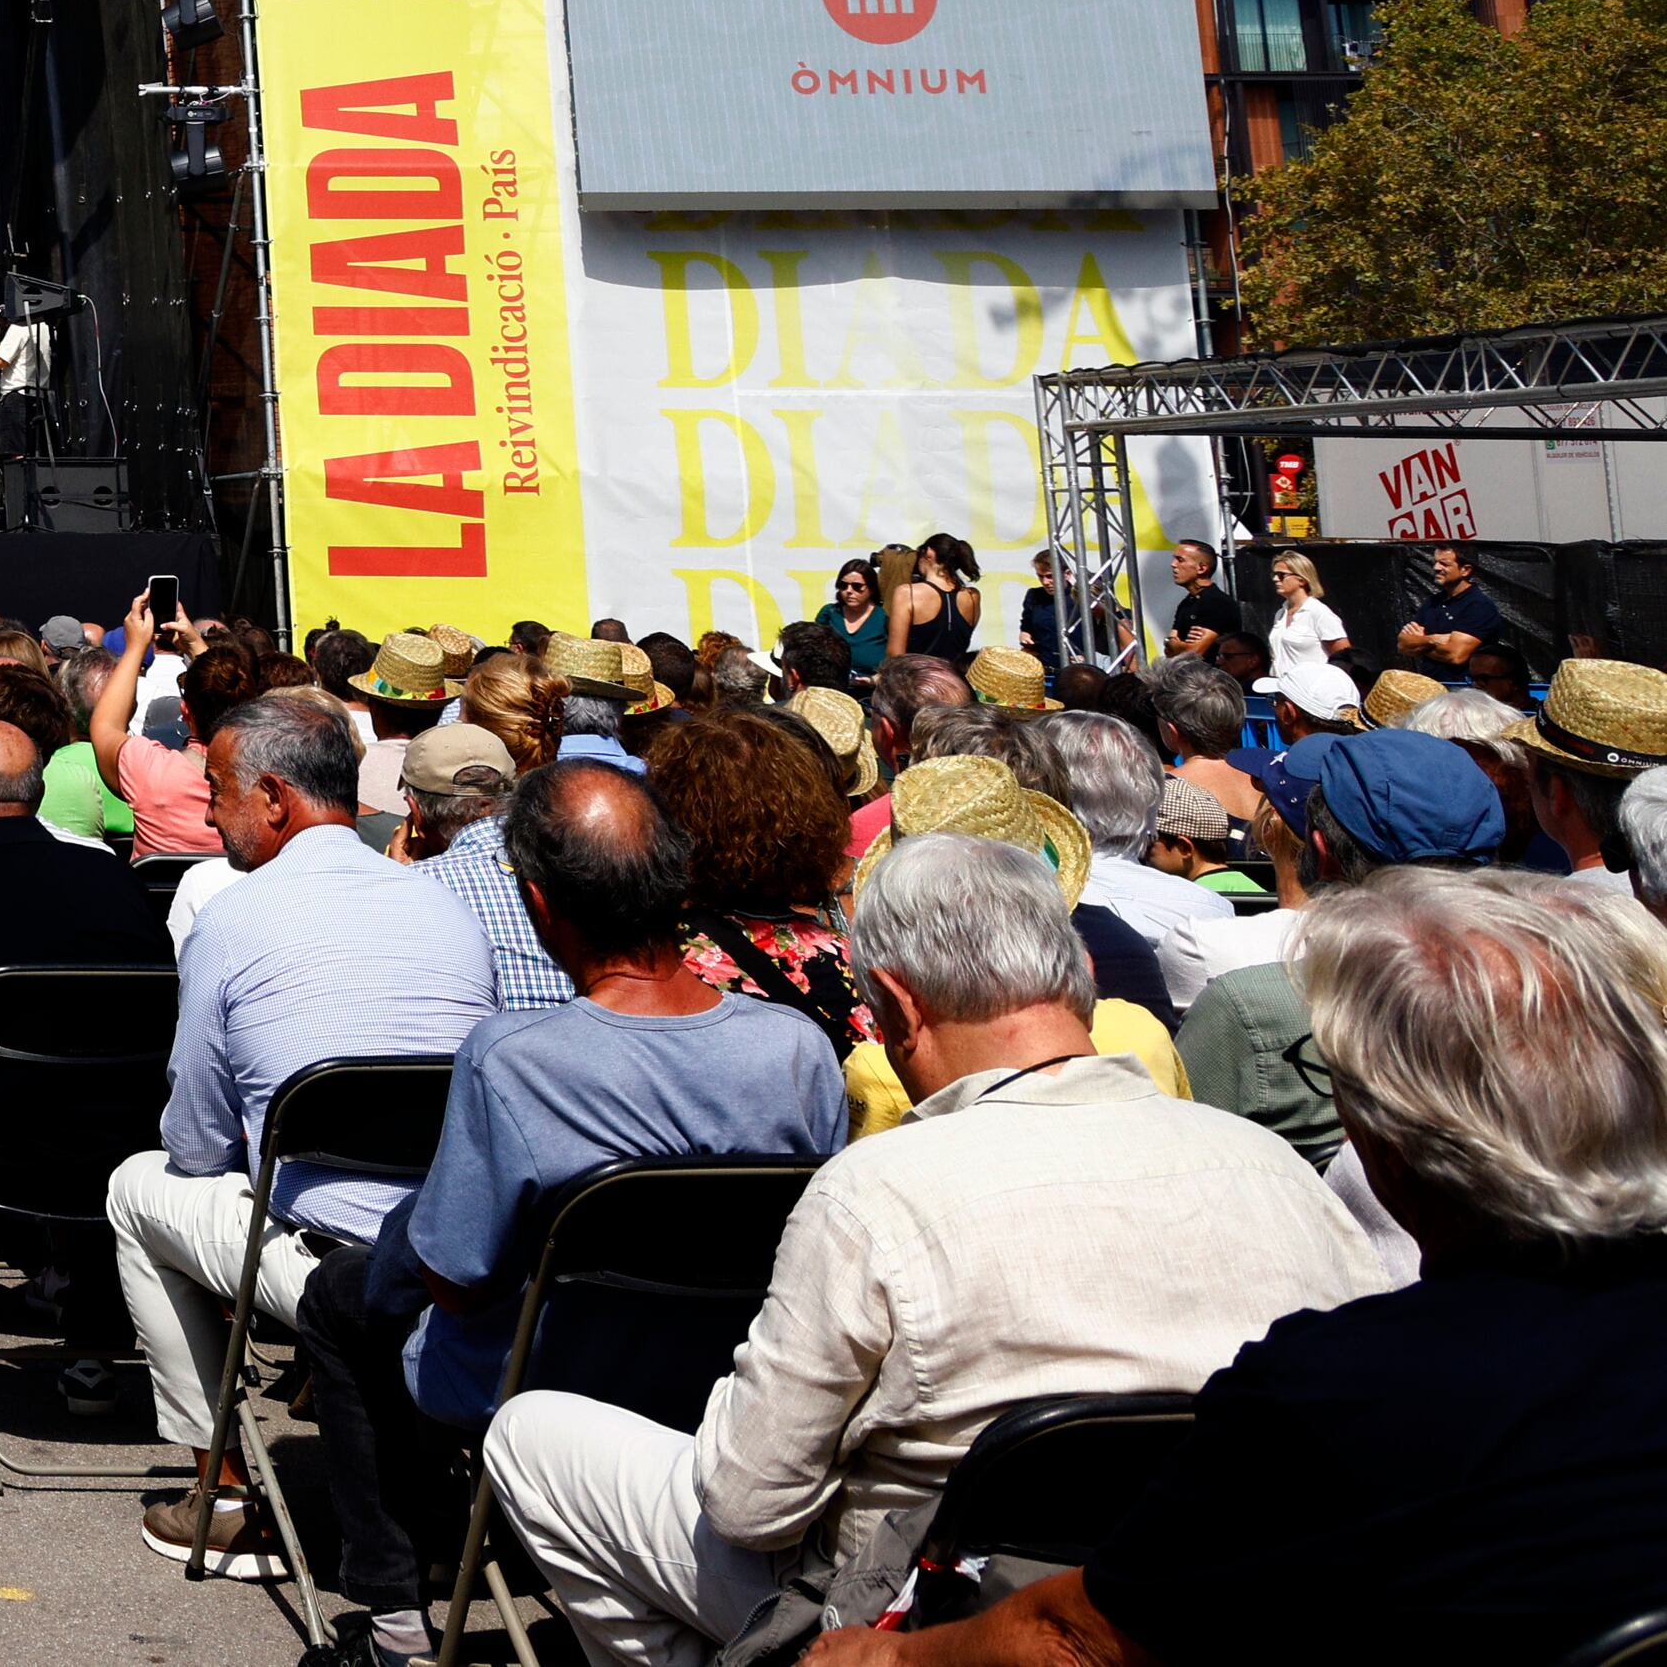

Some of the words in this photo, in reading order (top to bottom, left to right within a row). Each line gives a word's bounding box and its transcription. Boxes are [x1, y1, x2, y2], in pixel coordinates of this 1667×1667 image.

[791, 61, 987, 95] ÒMNIUM
[481, 148, 519, 222] País
[300, 70, 478, 416] DIADA
[483, 251, 541, 497] Reivindicació
[324, 439, 488, 579] LA
[1378, 442, 1461, 511] VAN
